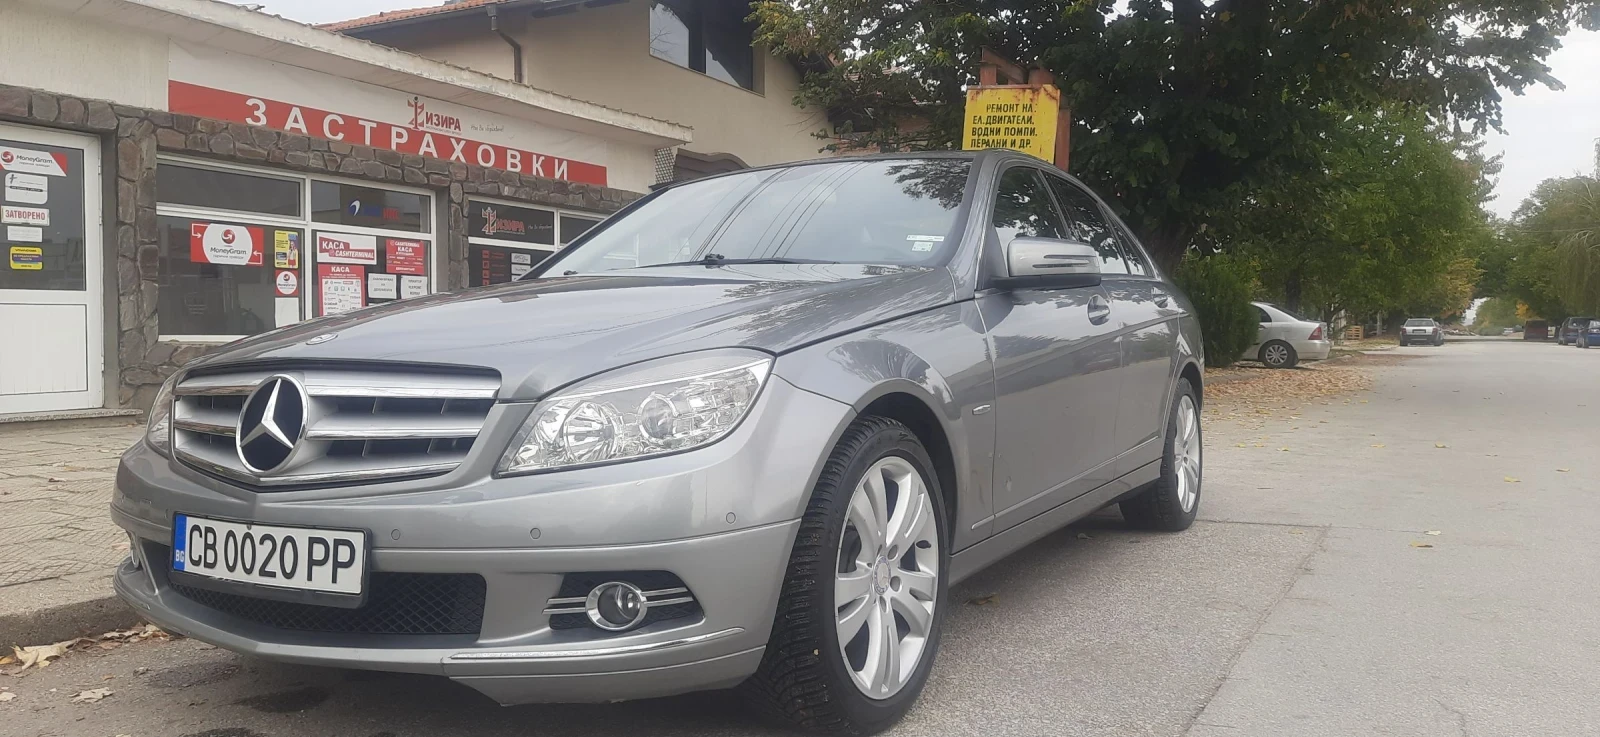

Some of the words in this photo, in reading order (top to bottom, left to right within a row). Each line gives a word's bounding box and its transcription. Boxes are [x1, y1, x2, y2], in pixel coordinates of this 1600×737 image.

[986, 103, 1019, 113] РЕМОНТ
[971, 127, 1001, 137] ВОДНИ
[1004, 127, 1038, 137] ПОМПИ.
[245, 98, 569, 181] ЗАСТРАХОВКИ
[970, 138, 1008, 148] ПЕРАЛНИ
[1010, 138, 1016, 148] И
[1019, 138, 1032, 149] ДР.
[16, 154, 53, 164] MoneyGram
[5, 209, 46, 221] ЗАТВОРЕНО
[322, 240, 345, 250] КАСА
[210, 246, 247, 255] MoneyGram
[335, 249, 374, 259] CASHTERMINAL
[175, 550, 185, 563] BG
[188, 524, 218, 569] CB
[224, 529, 298, 580] 0020
[306, 536, 356, 584] PP
